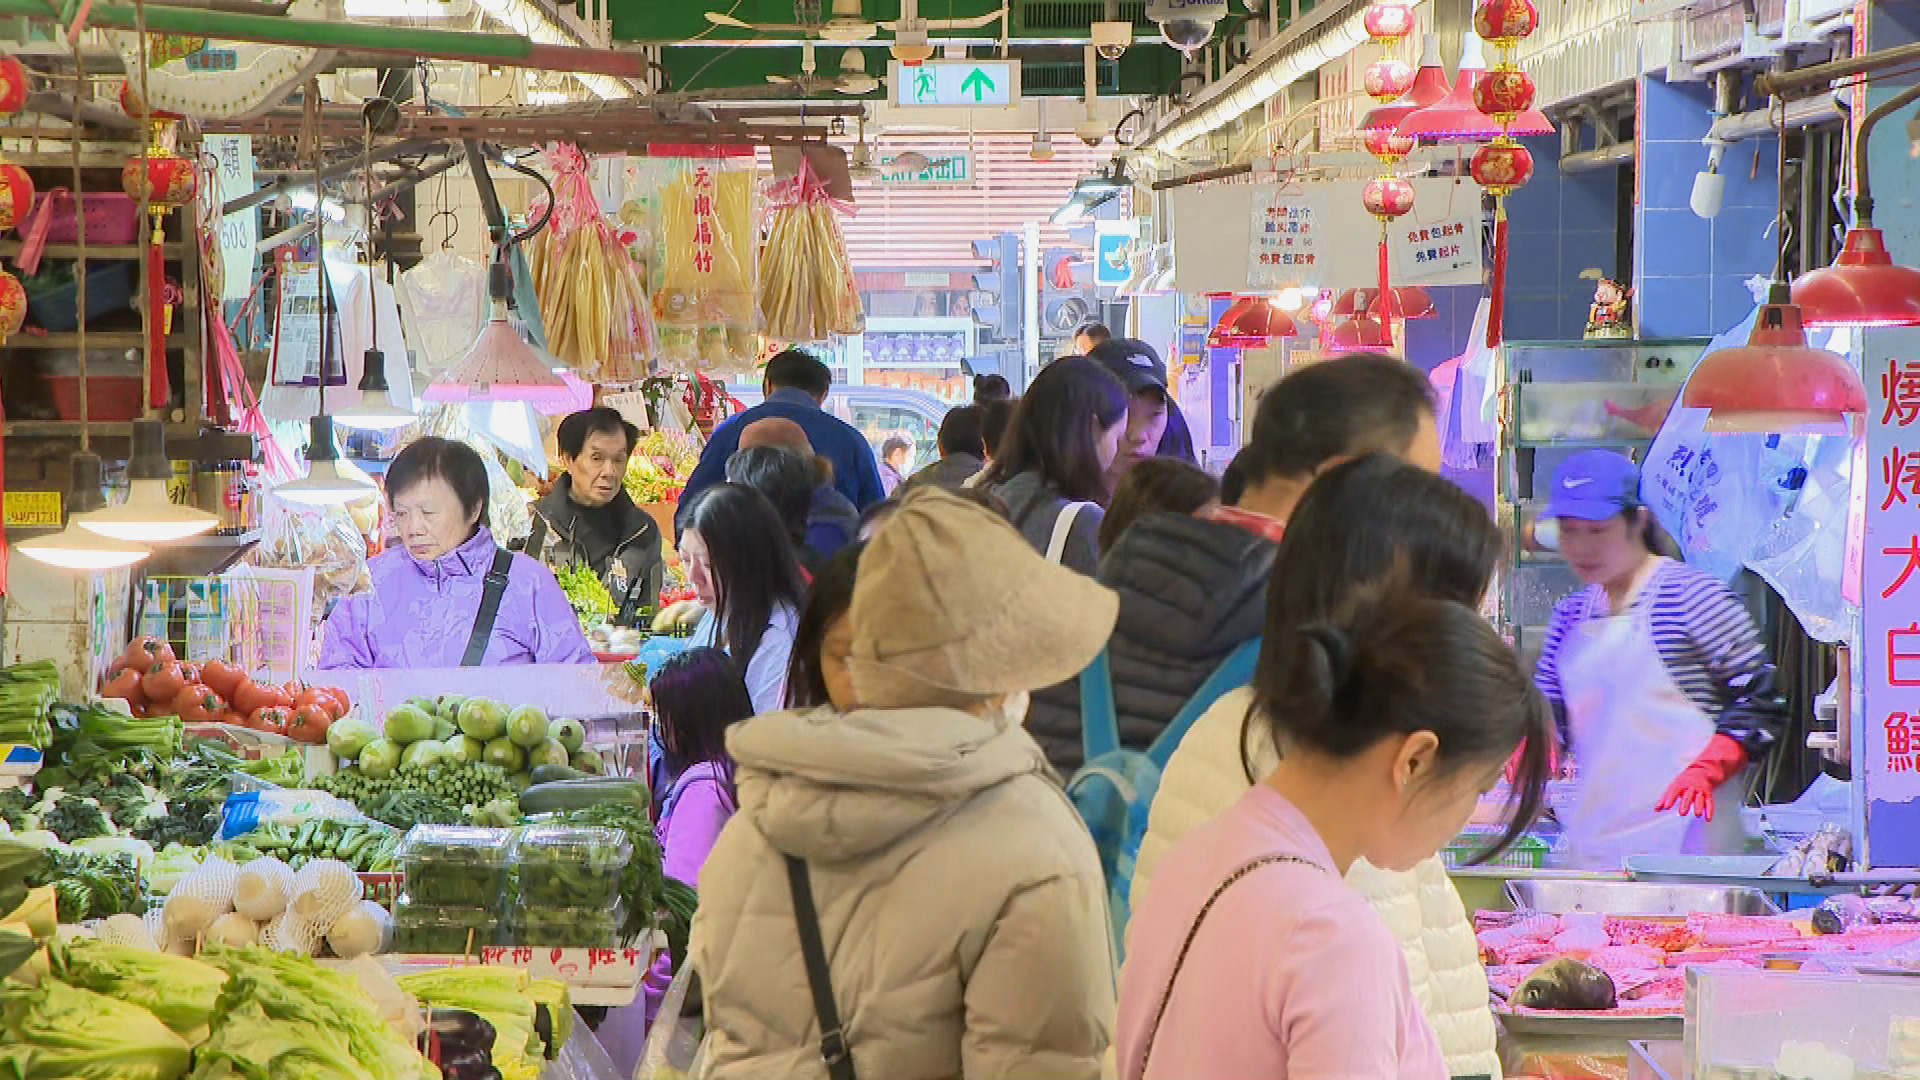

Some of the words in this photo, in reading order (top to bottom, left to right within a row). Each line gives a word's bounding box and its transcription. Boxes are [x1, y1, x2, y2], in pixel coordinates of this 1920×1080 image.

[1406, 223, 1464, 242] 免費包起骨
[1259, 253, 1316, 265] 免費包起骨
